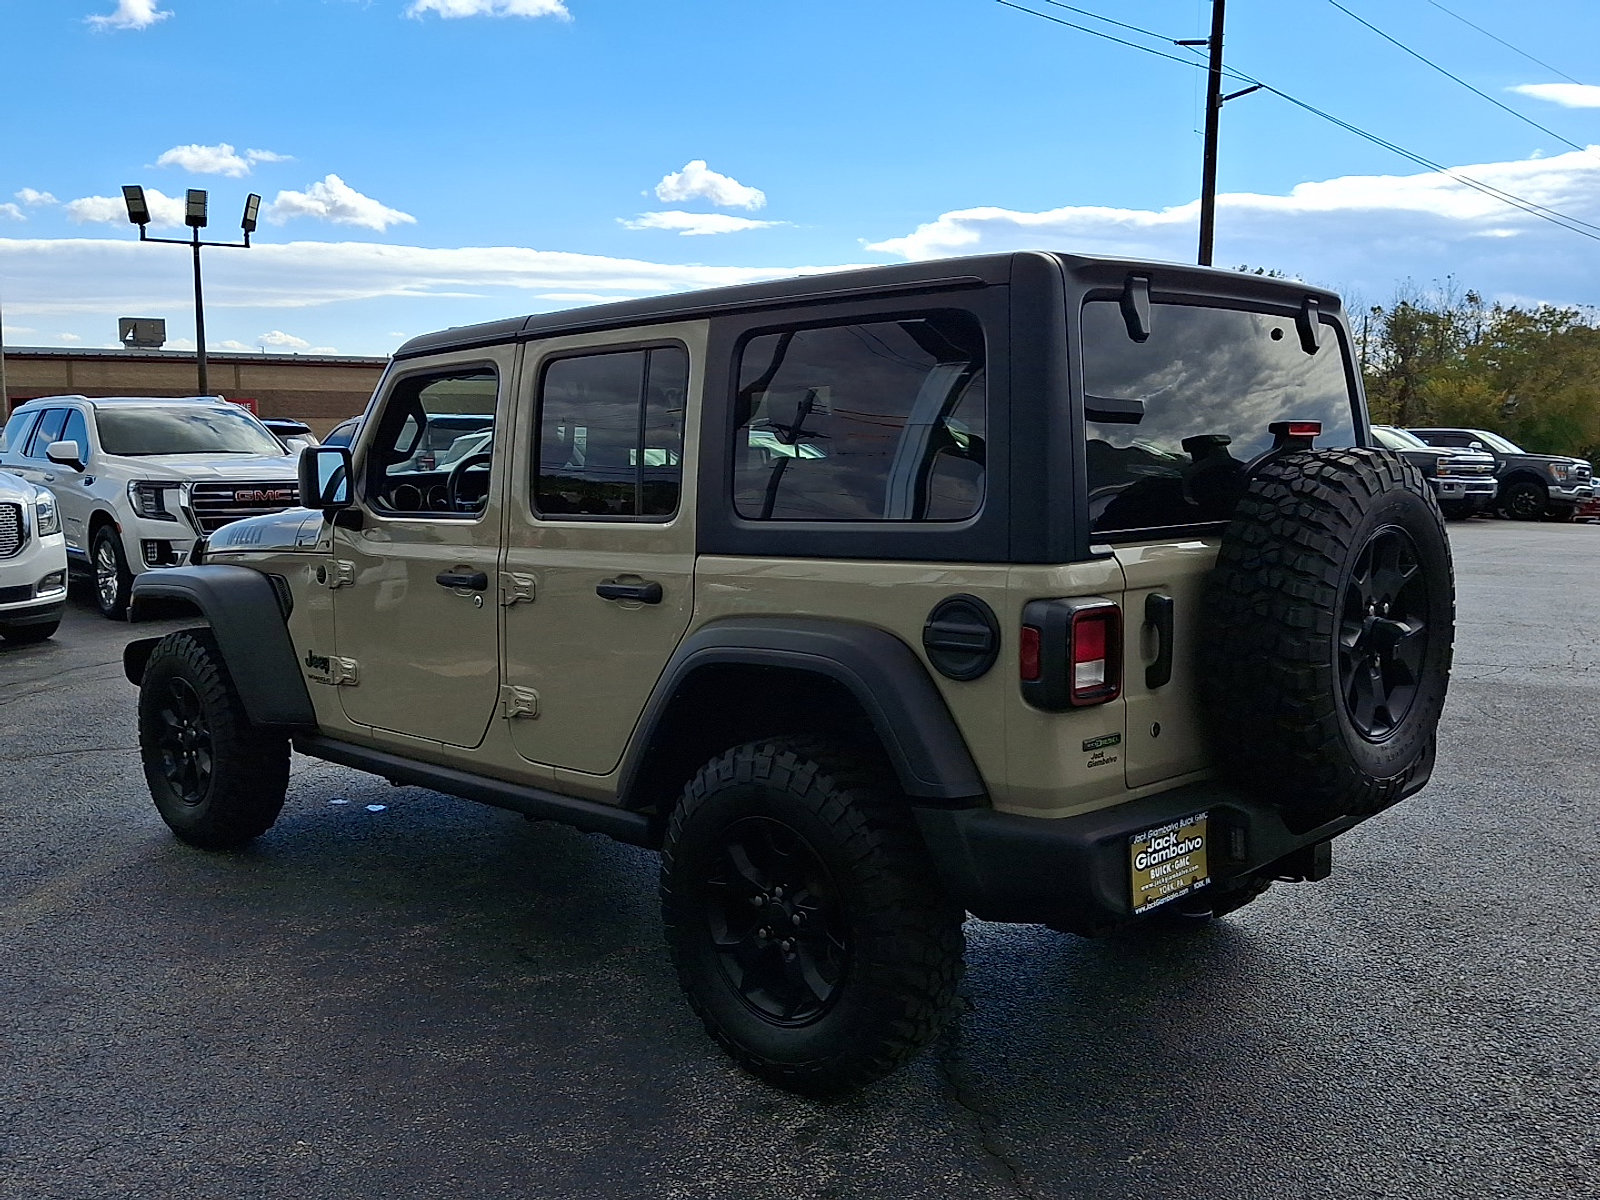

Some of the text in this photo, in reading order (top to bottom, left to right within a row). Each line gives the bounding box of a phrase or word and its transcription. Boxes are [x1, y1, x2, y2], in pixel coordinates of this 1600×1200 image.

[235, 489, 292, 501] GMC
[305, 649, 330, 674] Jeep
[1148, 823, 1179, 839] Giambalvo
[1194, 811, 1209, 821] GMC
[1135, 837, 1202, 869] Giambalvo
[1147, 832, 1178, 852] Jack
